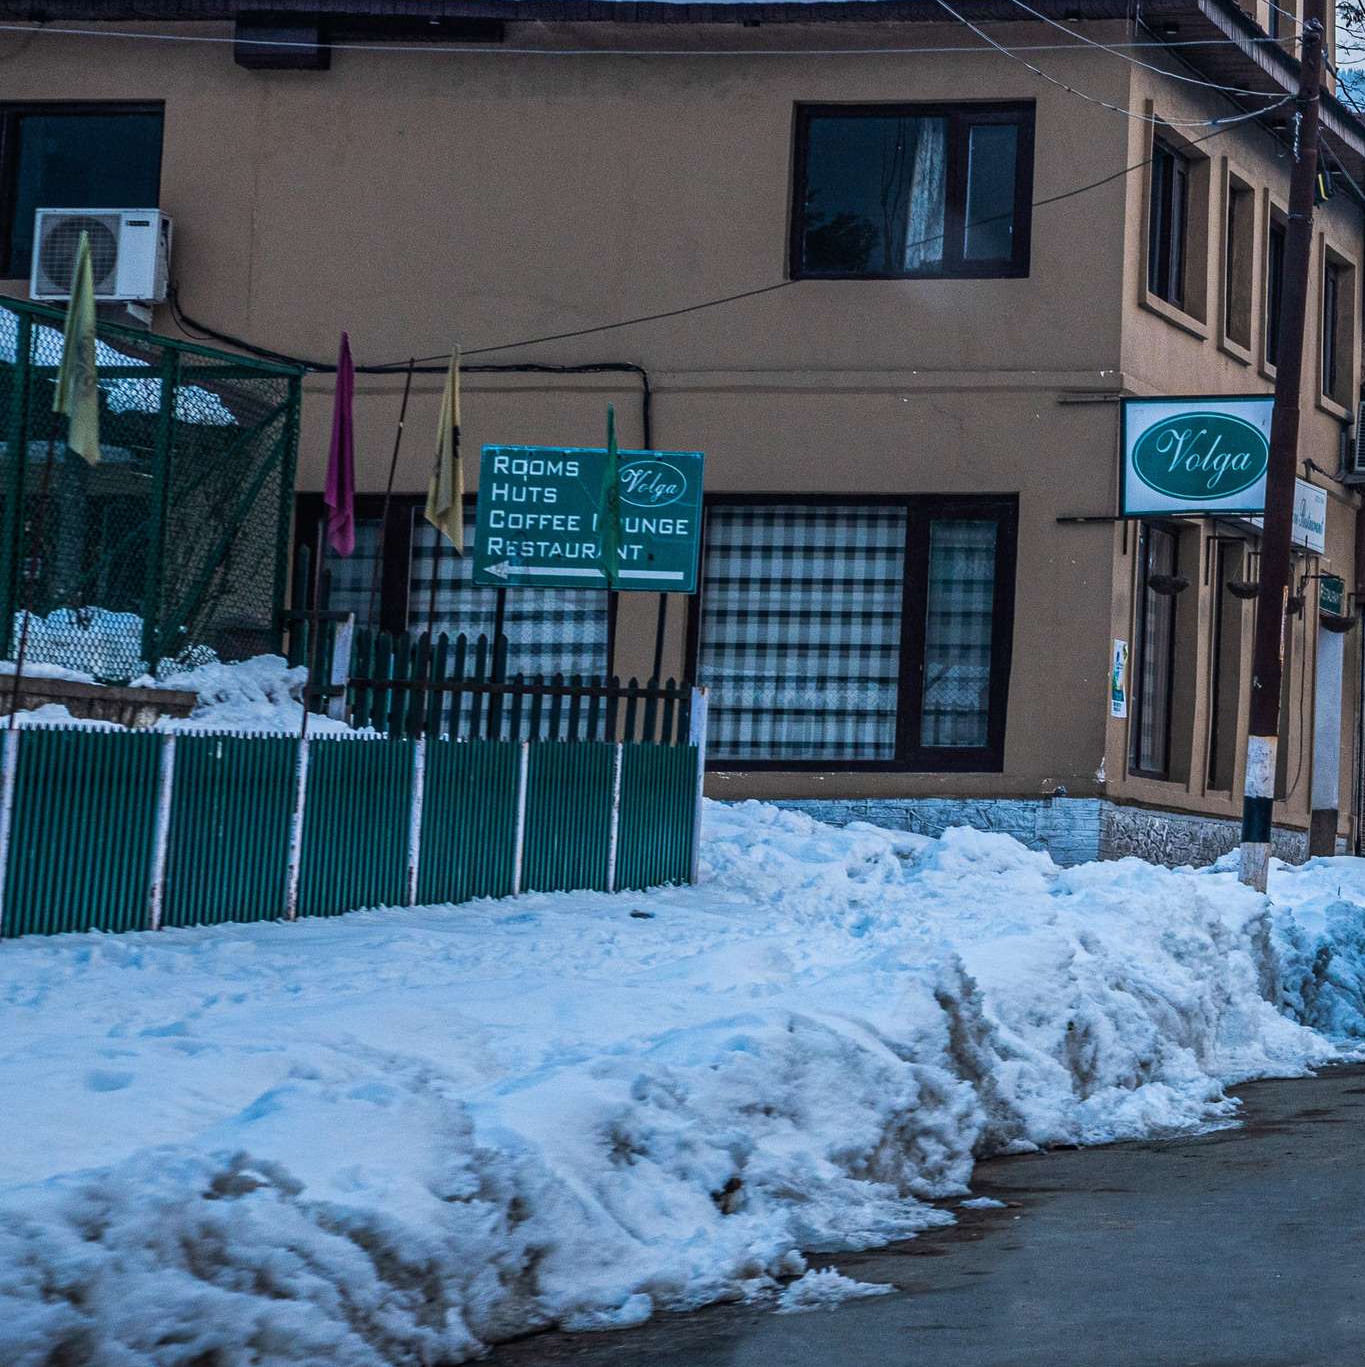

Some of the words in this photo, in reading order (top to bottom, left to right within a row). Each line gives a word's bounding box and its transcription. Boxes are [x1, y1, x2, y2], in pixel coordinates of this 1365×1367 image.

[493, 456, 579, 477] ROOMS
[1156, 429, 1252, 489] Volga
[491, 483, 558, 503] HUTS
[620, 468, 679, 502] Volga
[489, 510, 581, 532] COFFEE
[592, 513, 689, 535] LUNGE
[487, 537, 644, 560] RESTAURNT
